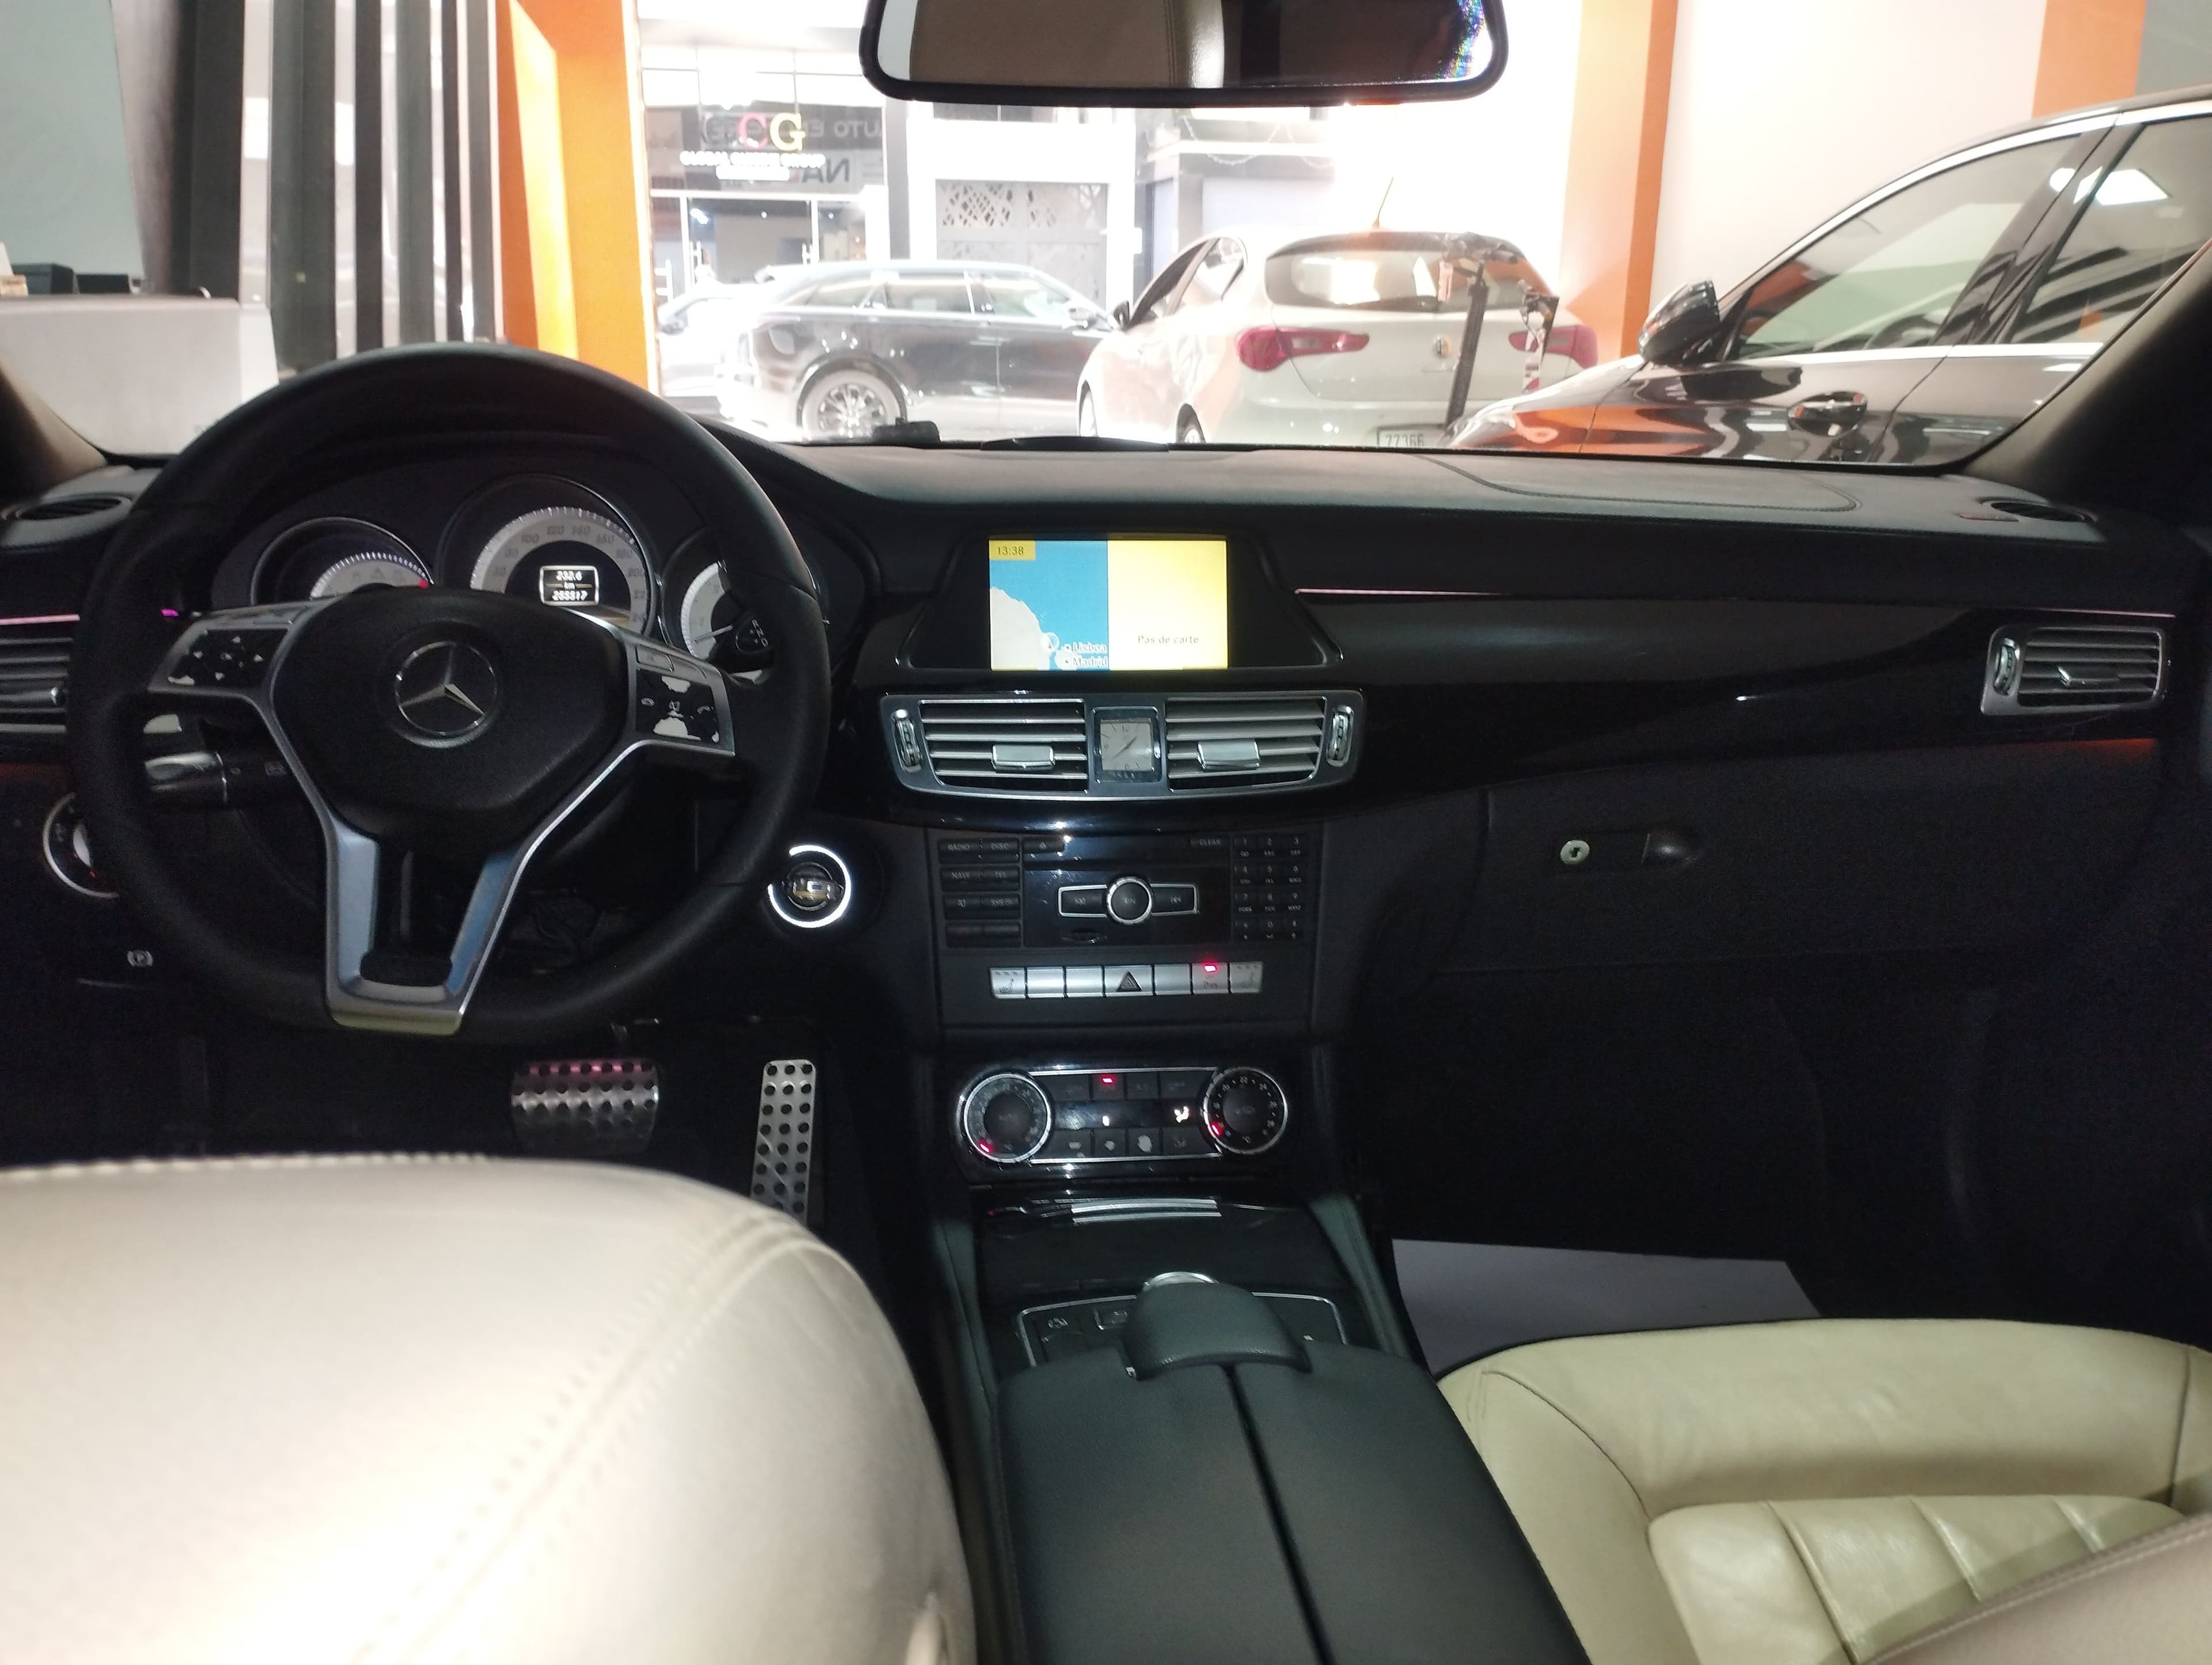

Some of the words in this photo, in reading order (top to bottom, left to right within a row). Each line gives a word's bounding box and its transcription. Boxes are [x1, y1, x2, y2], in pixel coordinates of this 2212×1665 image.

[998, 546, 1024, 556] 13:38
[1138, 635, 1156, 644] Pas
[1158, 635, 1171, 644] de
[1174, 635, 1199, 644] carte
[1073, 642, 1107, 653] Lisboa
[1073, 656, 1108, 667] Madrid
